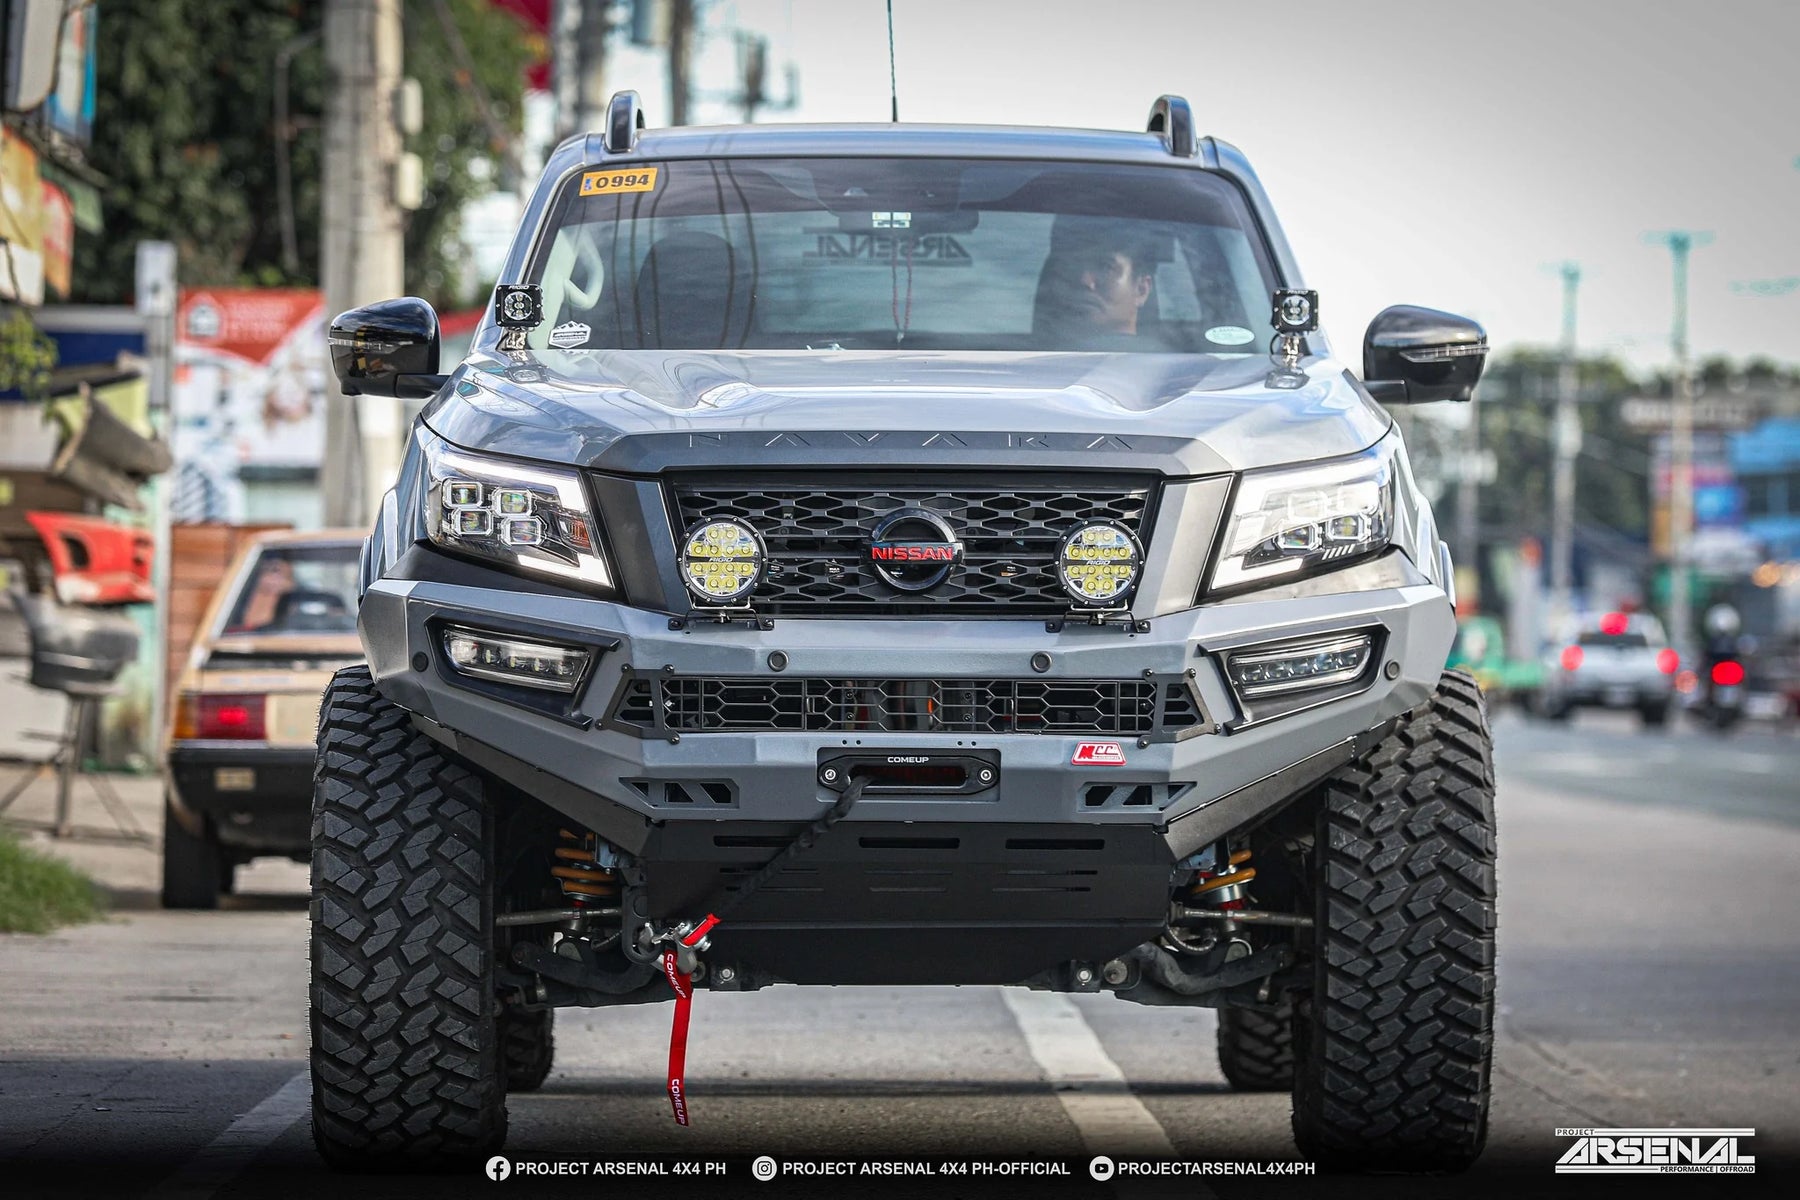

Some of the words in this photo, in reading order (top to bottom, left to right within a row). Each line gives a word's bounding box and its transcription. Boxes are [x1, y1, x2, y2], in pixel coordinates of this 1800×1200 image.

[689, 433, 1132, 449] NAVARA
[872, 546, 953, 561] NISSAN
[666, 953, 687, 999] COMEUP
[671, 1078, 686, 1125] COMEUP
